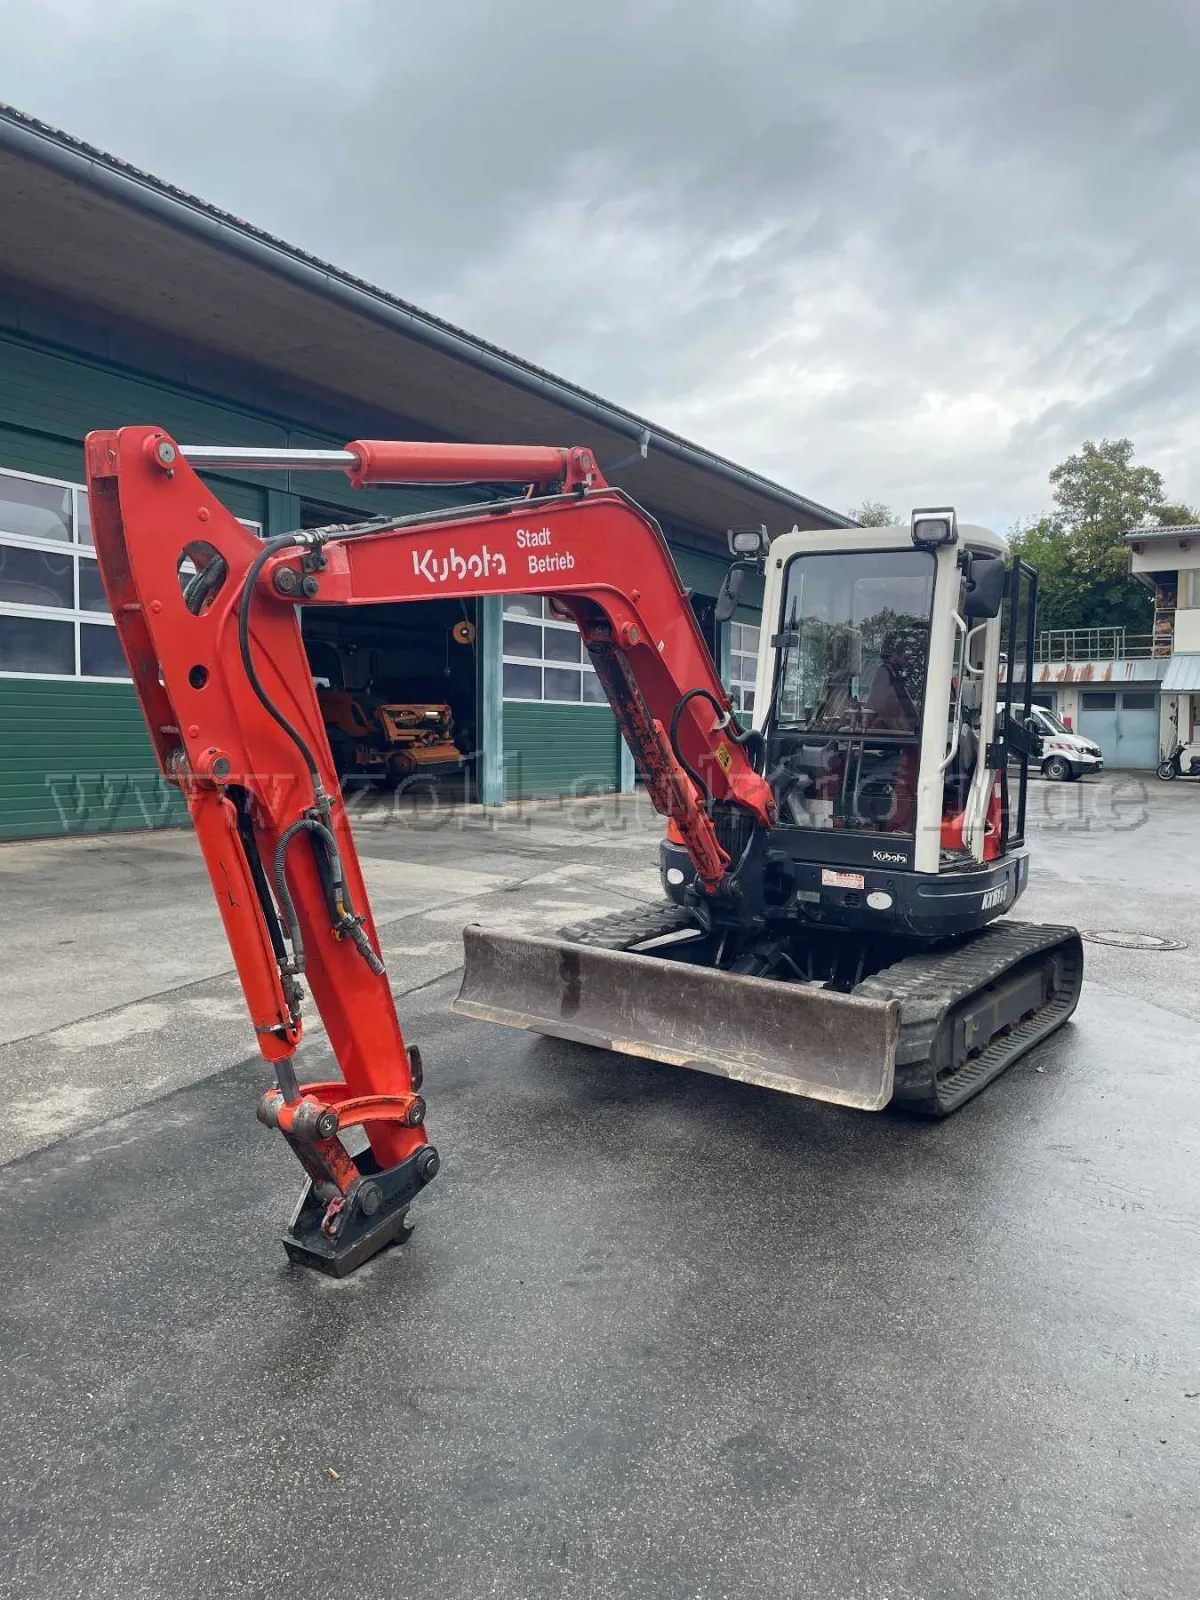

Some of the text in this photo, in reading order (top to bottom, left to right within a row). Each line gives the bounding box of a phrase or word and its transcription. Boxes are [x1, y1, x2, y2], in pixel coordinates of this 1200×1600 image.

[516, 527, 551, 548] Stadt
[412, 545, 507, 583] Kubota
[528, 551, 575, 574] Betrieb
[873, 850, 907, 863] Kubota
